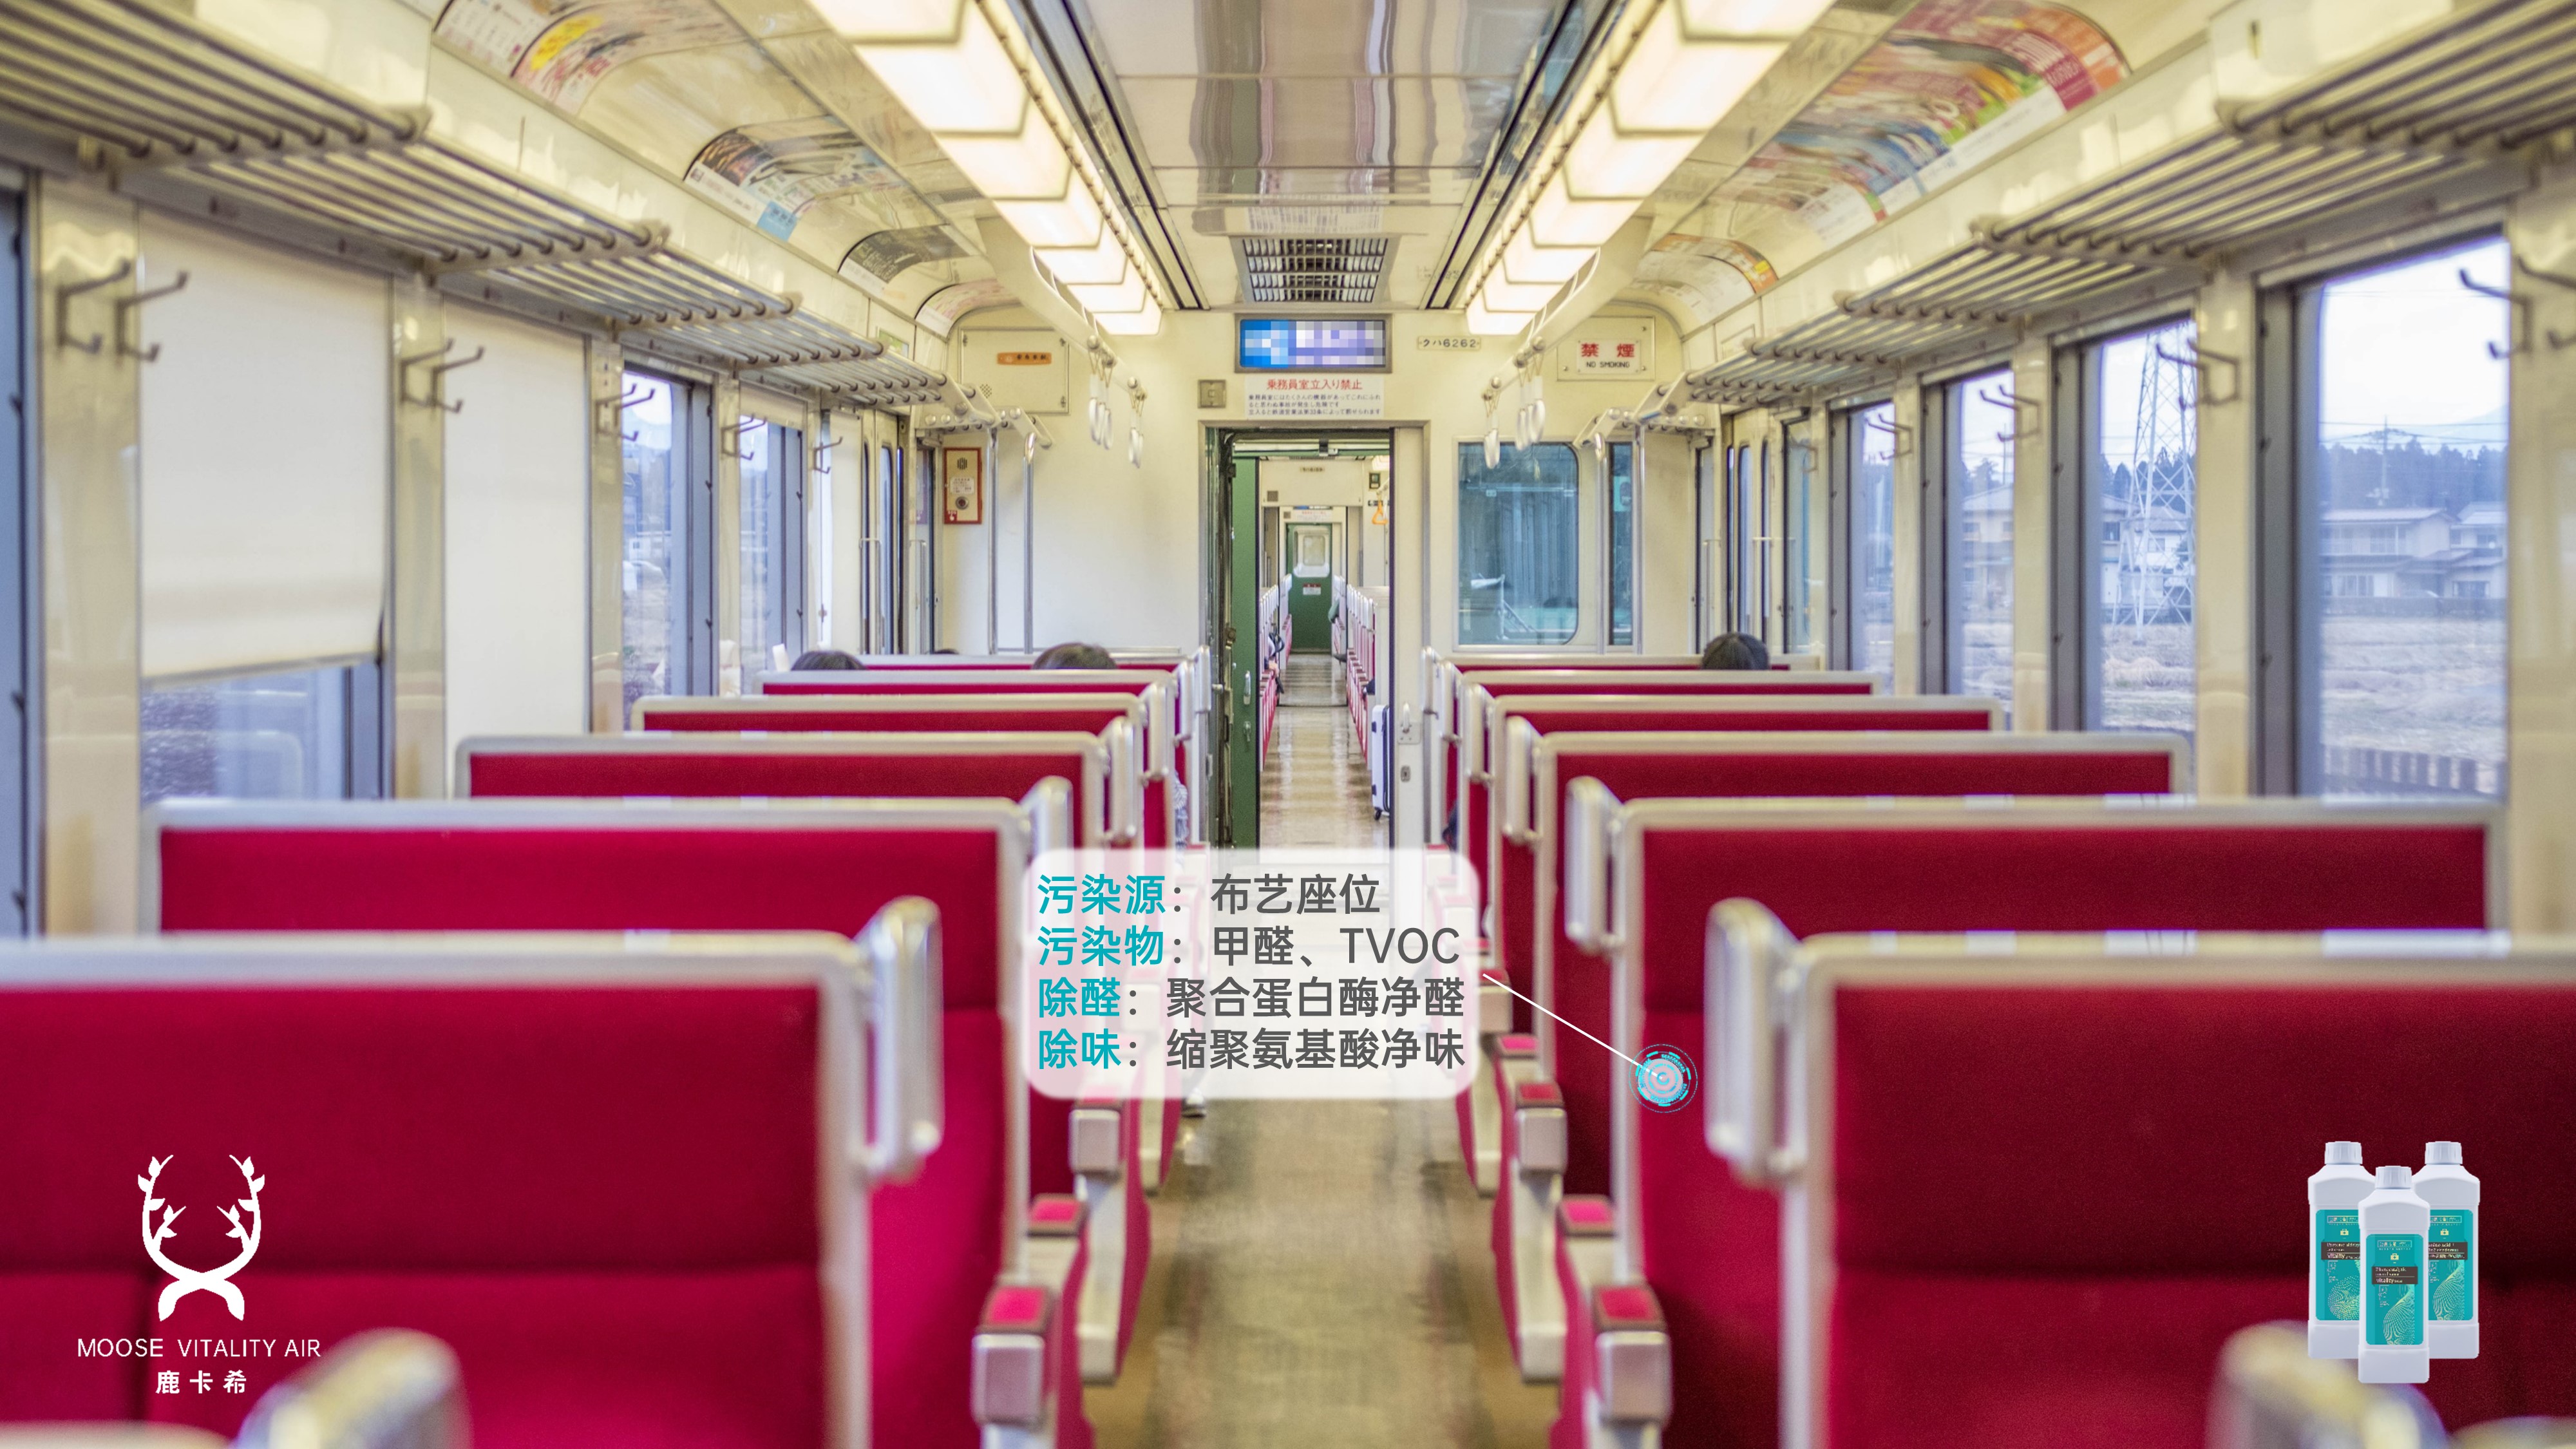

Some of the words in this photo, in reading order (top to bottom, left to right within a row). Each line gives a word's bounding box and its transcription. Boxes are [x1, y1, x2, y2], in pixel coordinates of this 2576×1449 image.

[1581, 343, 1635, 357] 禁煙
[1267, 378, 1363, 390] 乗務員室立入り禁止
